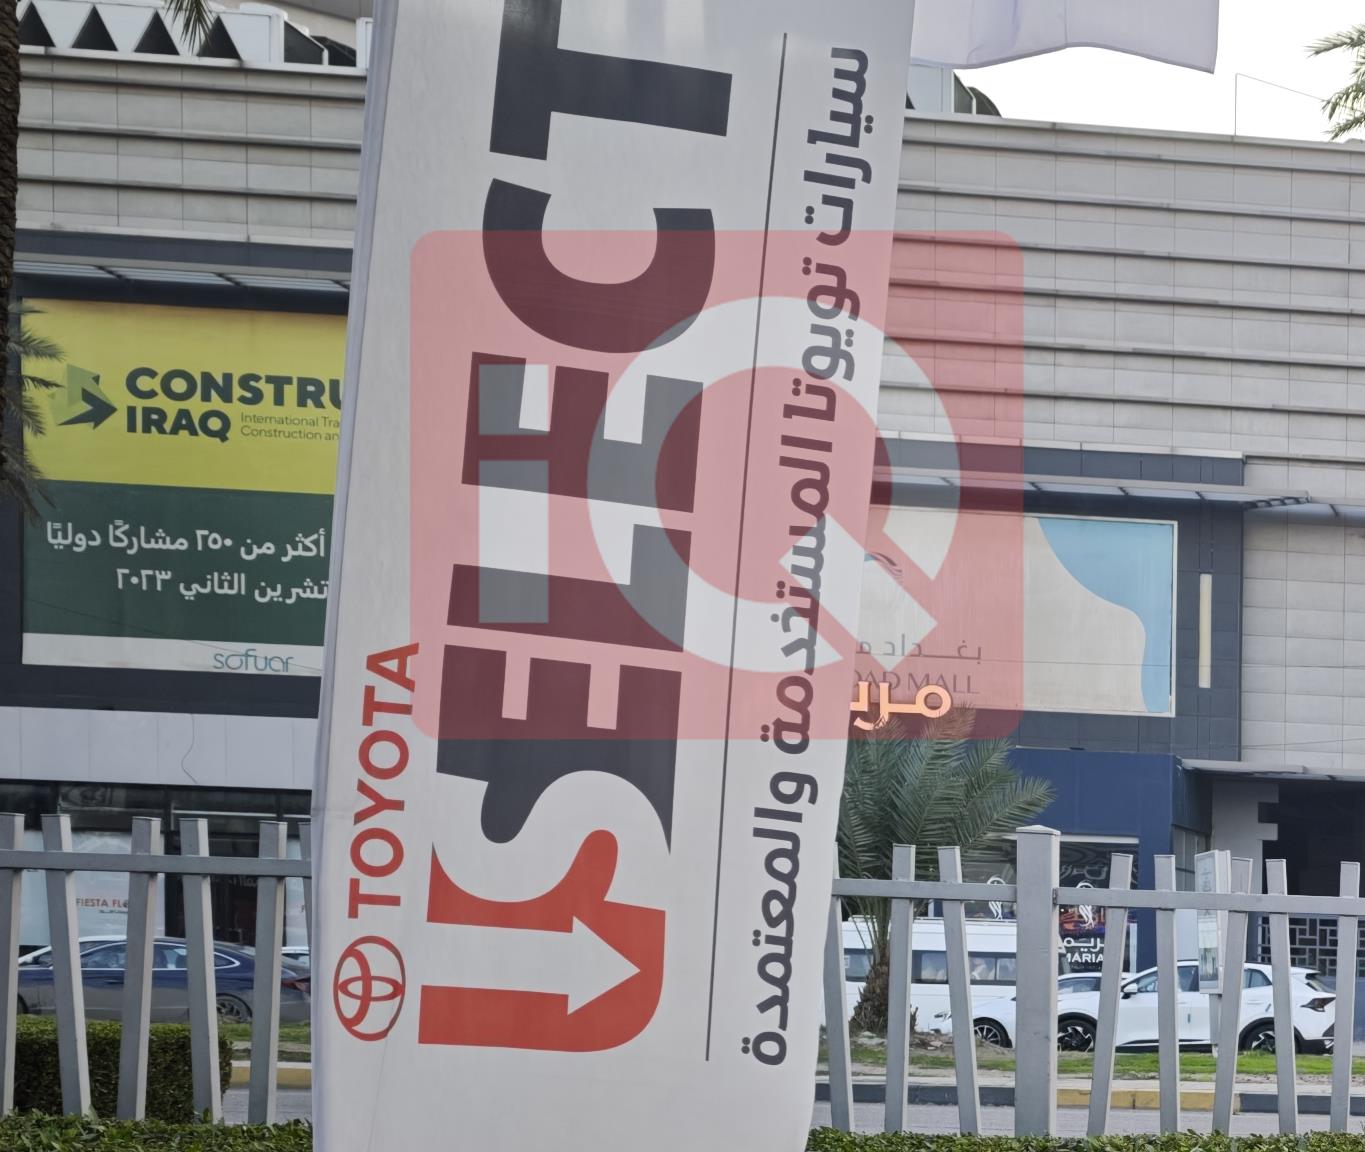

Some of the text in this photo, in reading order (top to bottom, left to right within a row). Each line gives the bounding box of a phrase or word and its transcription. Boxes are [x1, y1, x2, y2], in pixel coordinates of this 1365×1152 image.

[126, 405, 232, 443] IRAQ
[240, 425, 322, 440] Construction
[241, 412, 319, 427] International
[195, 529, 233, 551] ٢٥٠
[239, 540, 275, 560] من
[281, 528, 326, 562] أكثر
[741, 46, 874, 1066] سيارات تويوتا المستخدمة والمعتمدة
[116, 568, 172, 592] ٢٠٢٣
[179, 572, 246, 600] الثاني
[348, 642, 420, 920] TOYOTA
